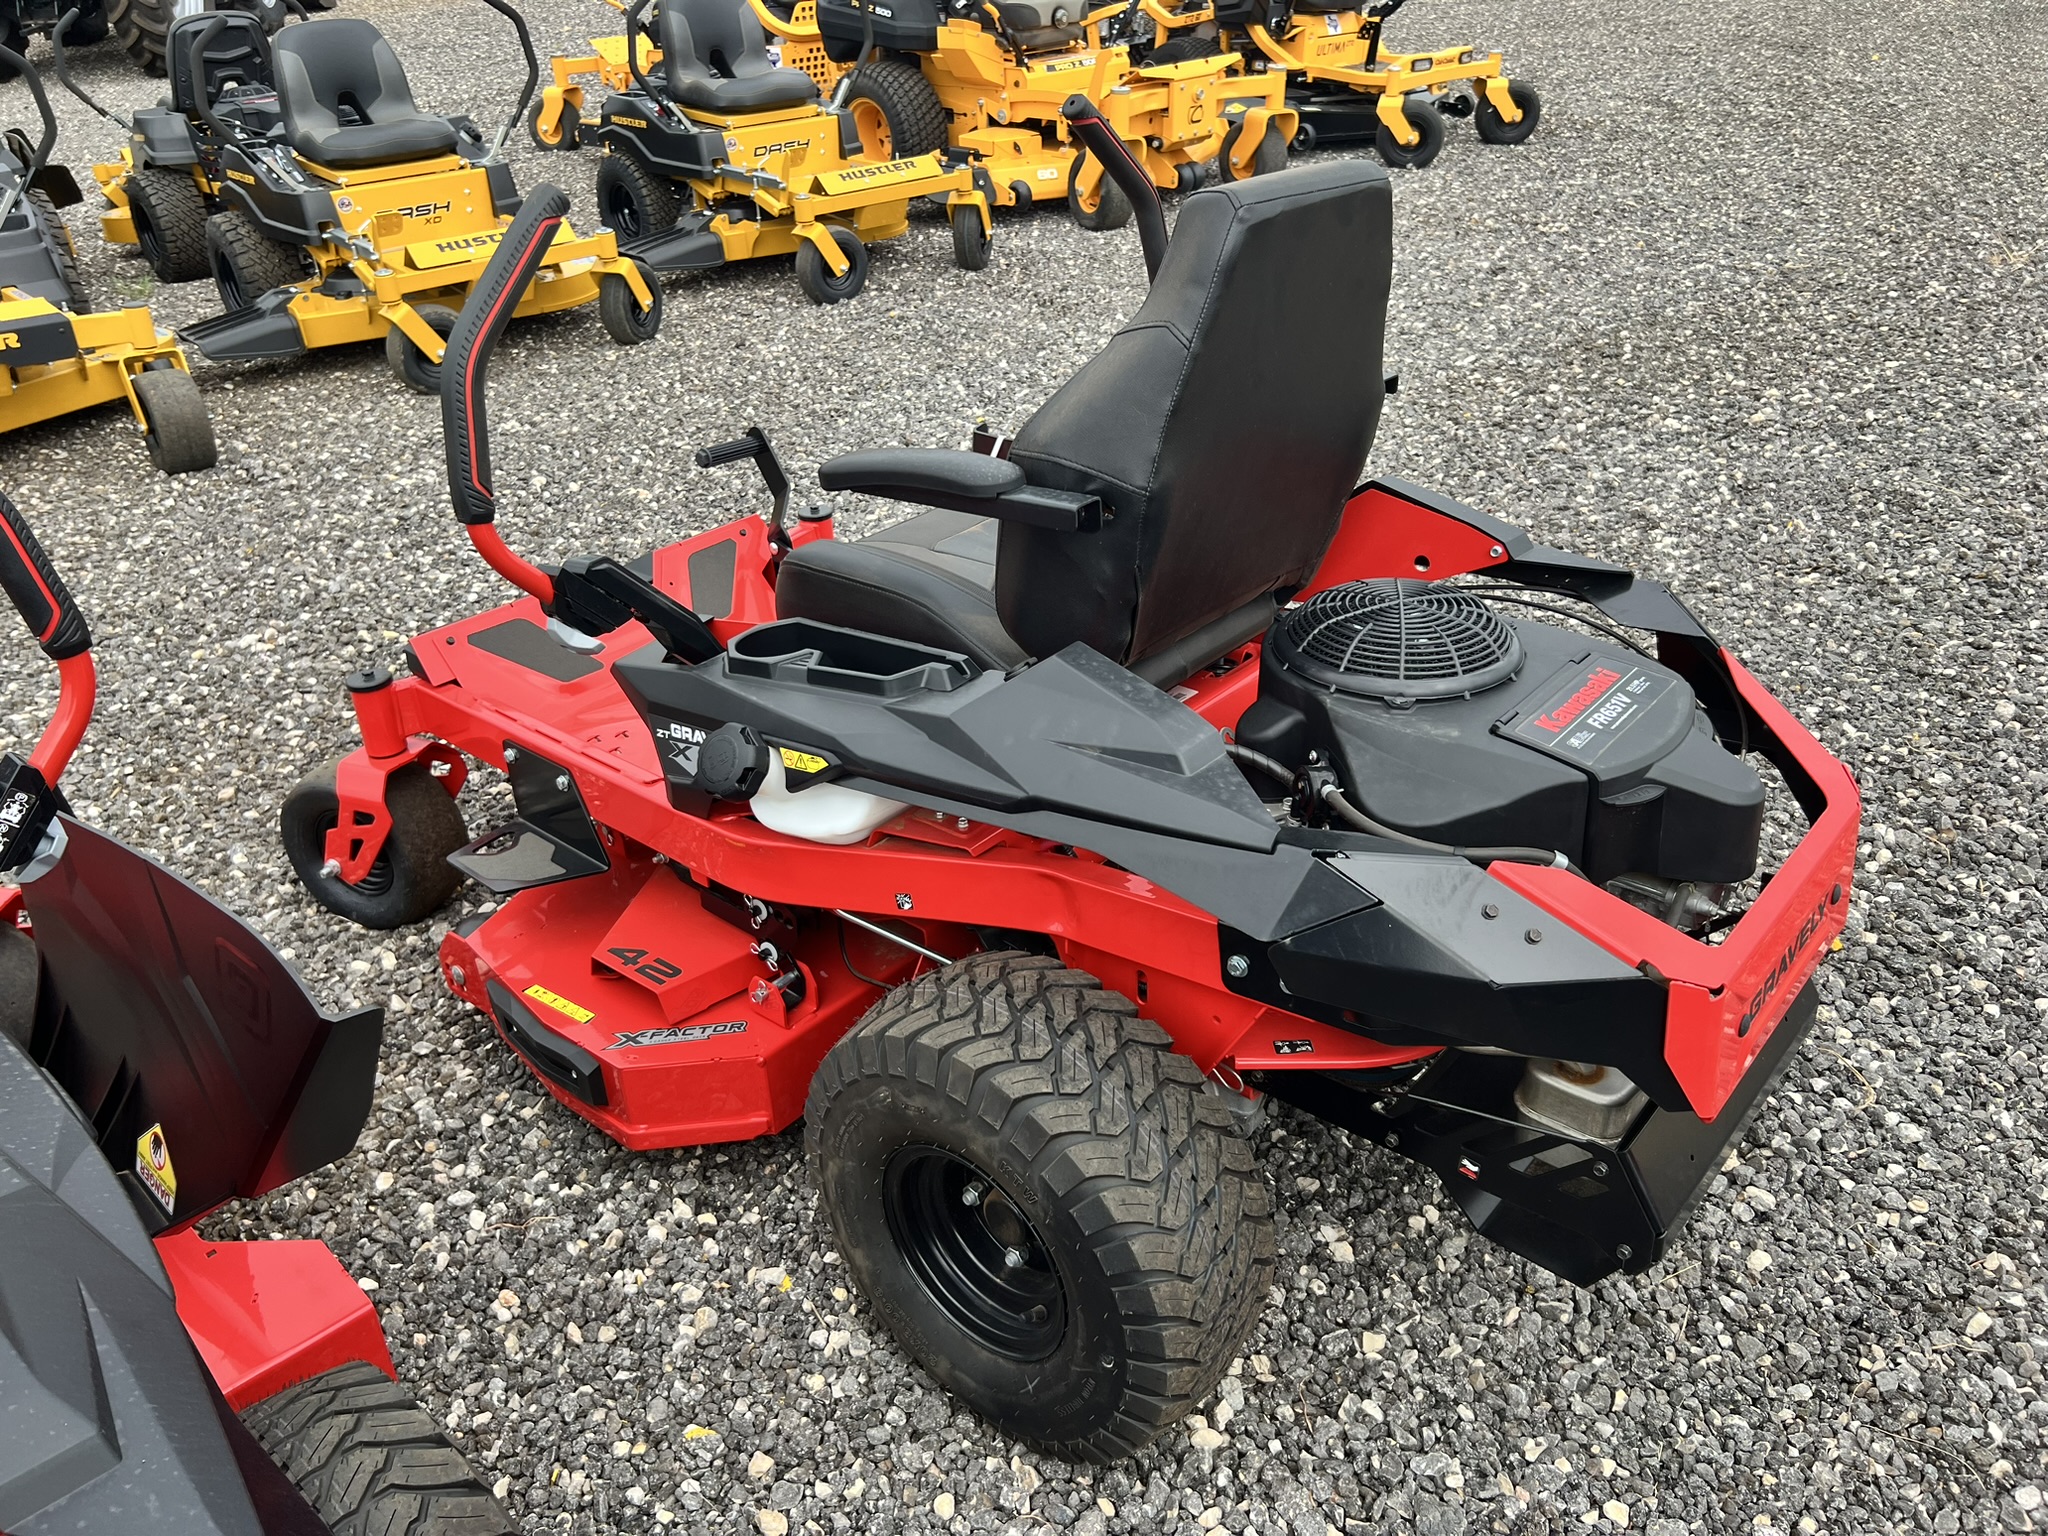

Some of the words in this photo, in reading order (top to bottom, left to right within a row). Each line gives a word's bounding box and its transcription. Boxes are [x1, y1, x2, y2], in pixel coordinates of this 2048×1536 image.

[611, 115, 647, 129] HUSTLER
[839, 160, 917, 181] HUSTLER
[424, 215, 443, 226] XD
[1534, 667, 1622, 733] Kawasaki
[1586, 692, 1632, 729] FR651V
[656, 728, 671, 739] ZT
[607, 947, 683, 986] 42
[1749, 892, 1829, 1021] GRAVELY
[614, 1020, 748, 1049] X-FACTOR
[140, 1160, 171, 1207] DANGER
